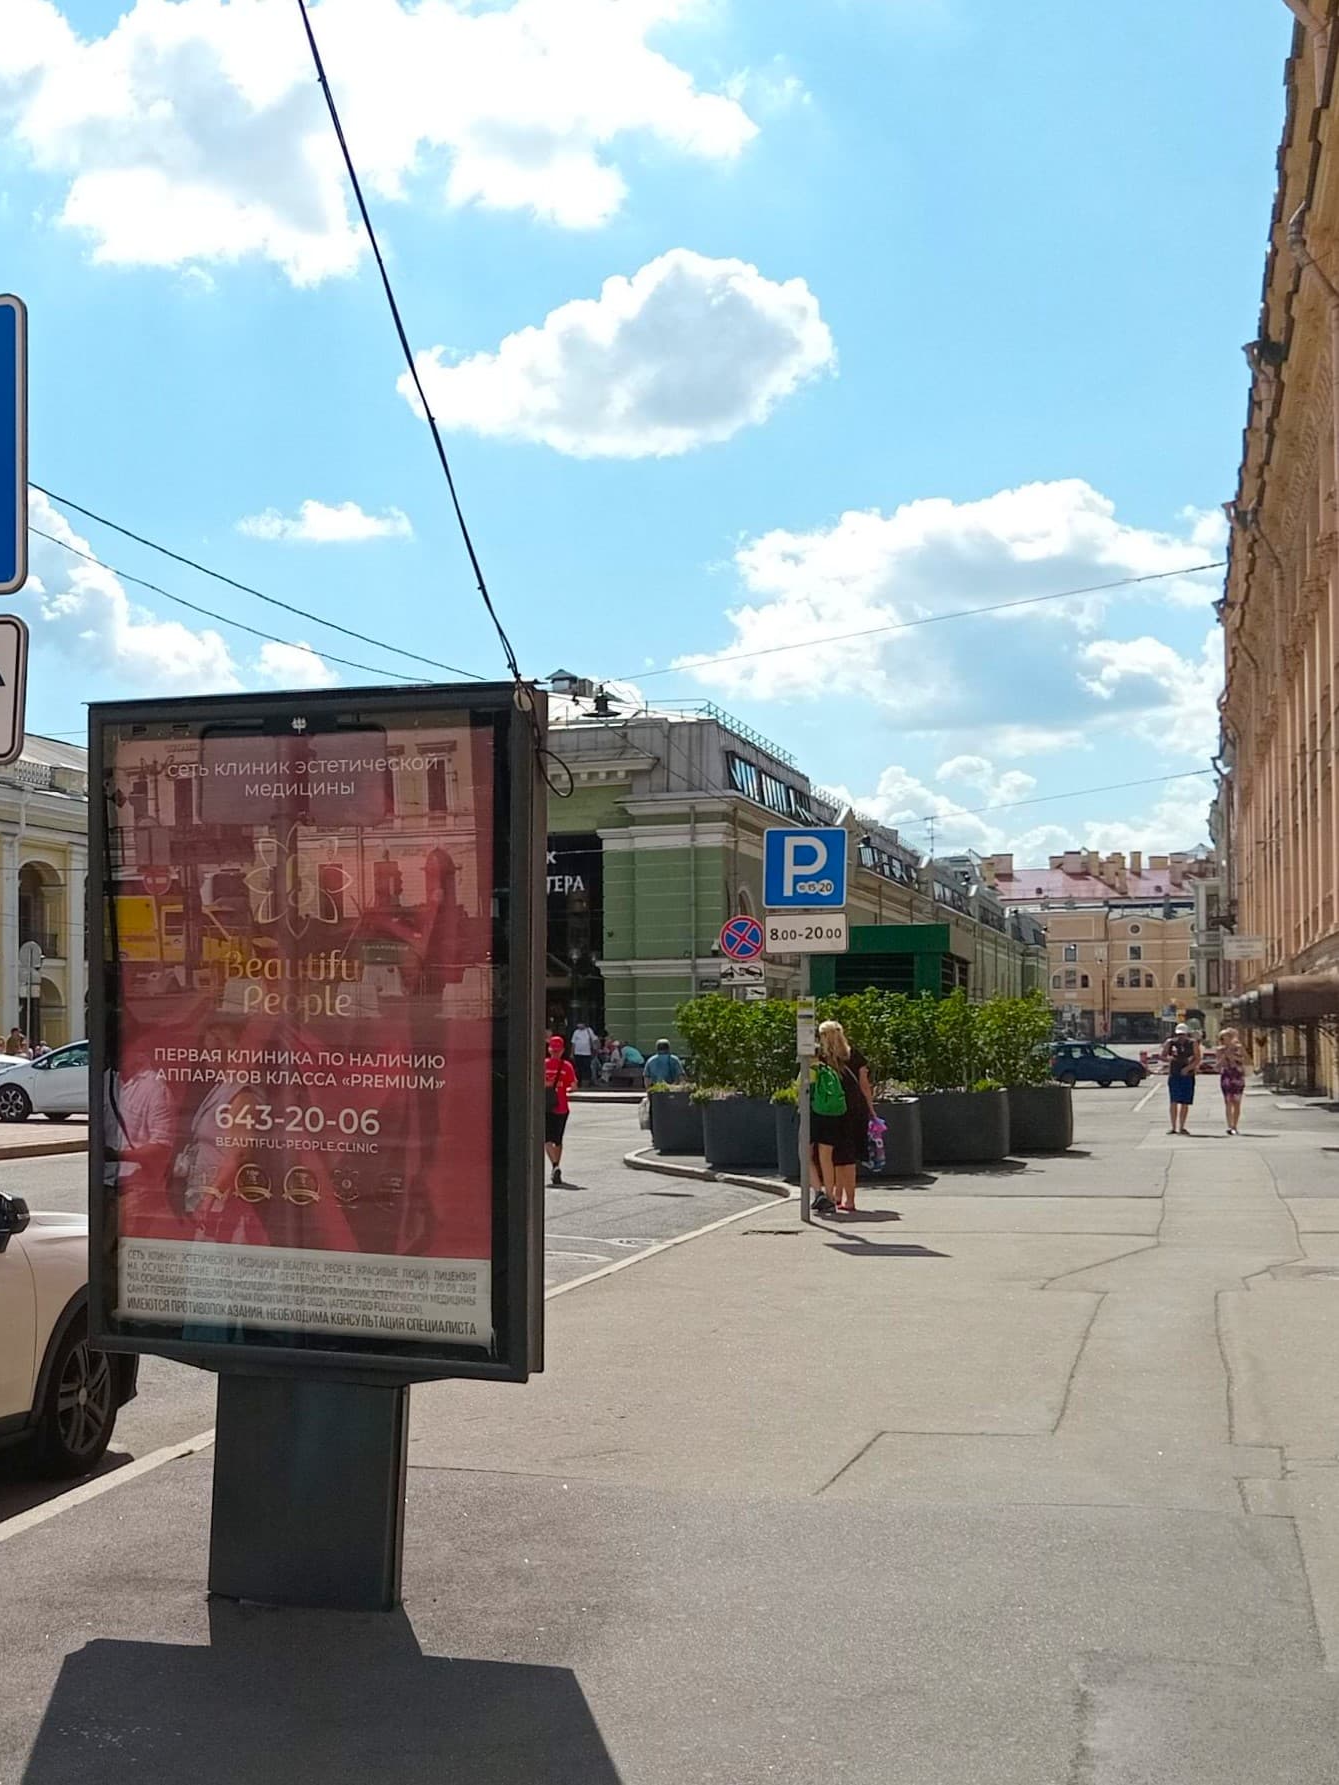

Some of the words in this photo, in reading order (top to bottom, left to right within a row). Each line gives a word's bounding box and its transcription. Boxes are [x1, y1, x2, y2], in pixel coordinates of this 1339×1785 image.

[167, 763, 209, 778] сеть
[214, 761, 290, 776] клиник
[295, 754, 438, 775] эстетической
[245, 780, 355, 799] медицины
[783, 836, 828, 897] P
[819, 882, 832, 892] 20
[223, 949, 362, 982] Beautifu
[243, 985, 352, 1023] People
[154, 1047, 222, 1064] ПЕРВАЯ
[227, 1049, 313, 1066] КЛИНИКА
[318, 1051, 345, 1067] ПО
[349, 1054, 446, 1070] НАЛИЧИЮ
[155, 1067, 261, 1085] АППАРАТОВ
[266, 1071, 337, 1087] КЛАССА
[342, 1073, 446, 1091] «PREMIUM»
[214, 1104, 381, 1136] 643-20-06
[215, 1136, 378, 1155] BEAUTIFUL-PEOPLE.CLINIC
